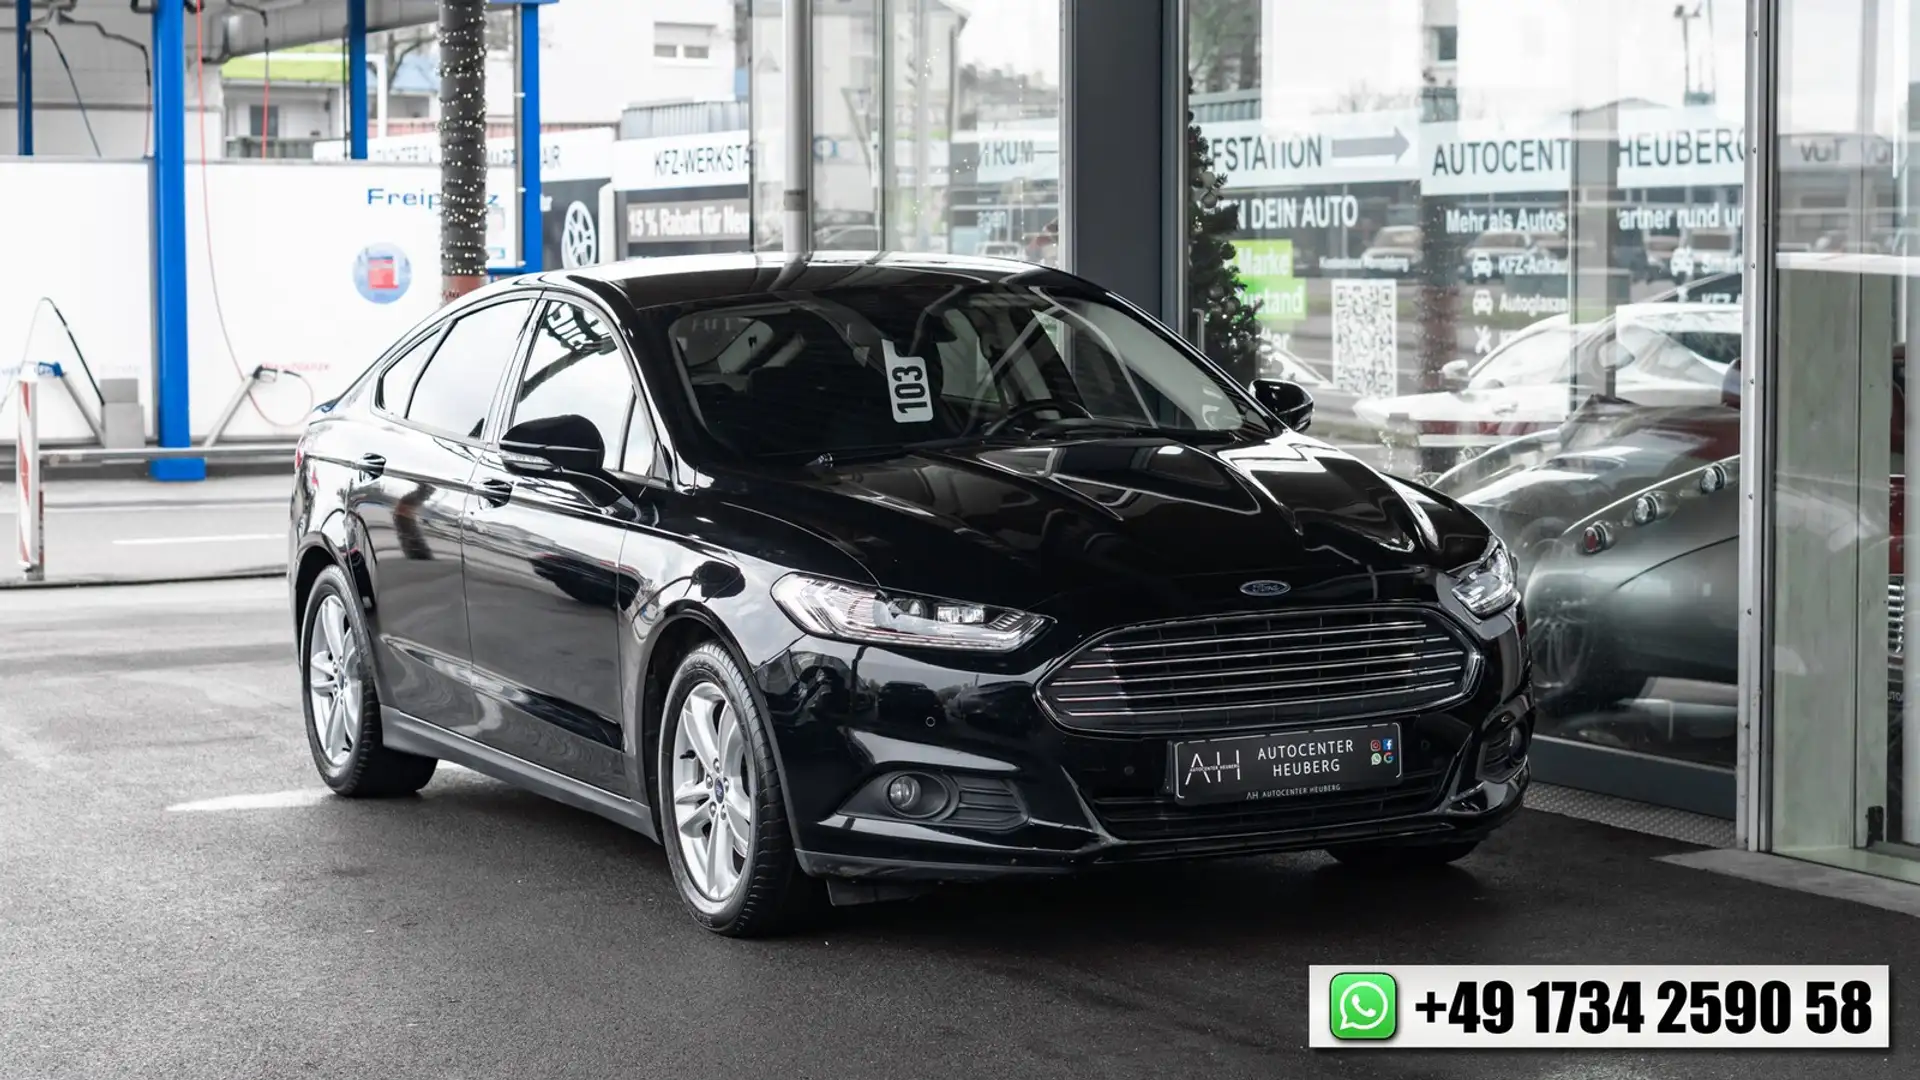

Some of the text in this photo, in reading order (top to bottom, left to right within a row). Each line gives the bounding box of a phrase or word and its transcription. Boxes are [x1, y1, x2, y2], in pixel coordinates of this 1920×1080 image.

[1433, 138, 1571, 176] AUTOCENT
[366, 187, 499, 210] Freipz
[1251, 197, 1297, 228] DEIN
[1300, 195, 1358, 227] AUTO
[628, 209, 644, 237] 15
[645, 208, 658, 237] %
[660, 208, 701, 237] Rabatt
[1446, 209, 1486, 233] Mehr
[1488, 207, 1514, 232] als
[1616, 206, 1673, 230] artner
[1676, 202, 1719, 228] rund
[1238, 247, 1290, 276] Marke
[892, 366, 928, 414] 103
[1257, 739, 1354, 761] AUTOCENTER
[1185, 749, 1241, 785] AH
[1272, 758, 1341, 778] HEUBERG
[1246, 783, 1341, 800] AH AUTOCENTER HEUBERG
